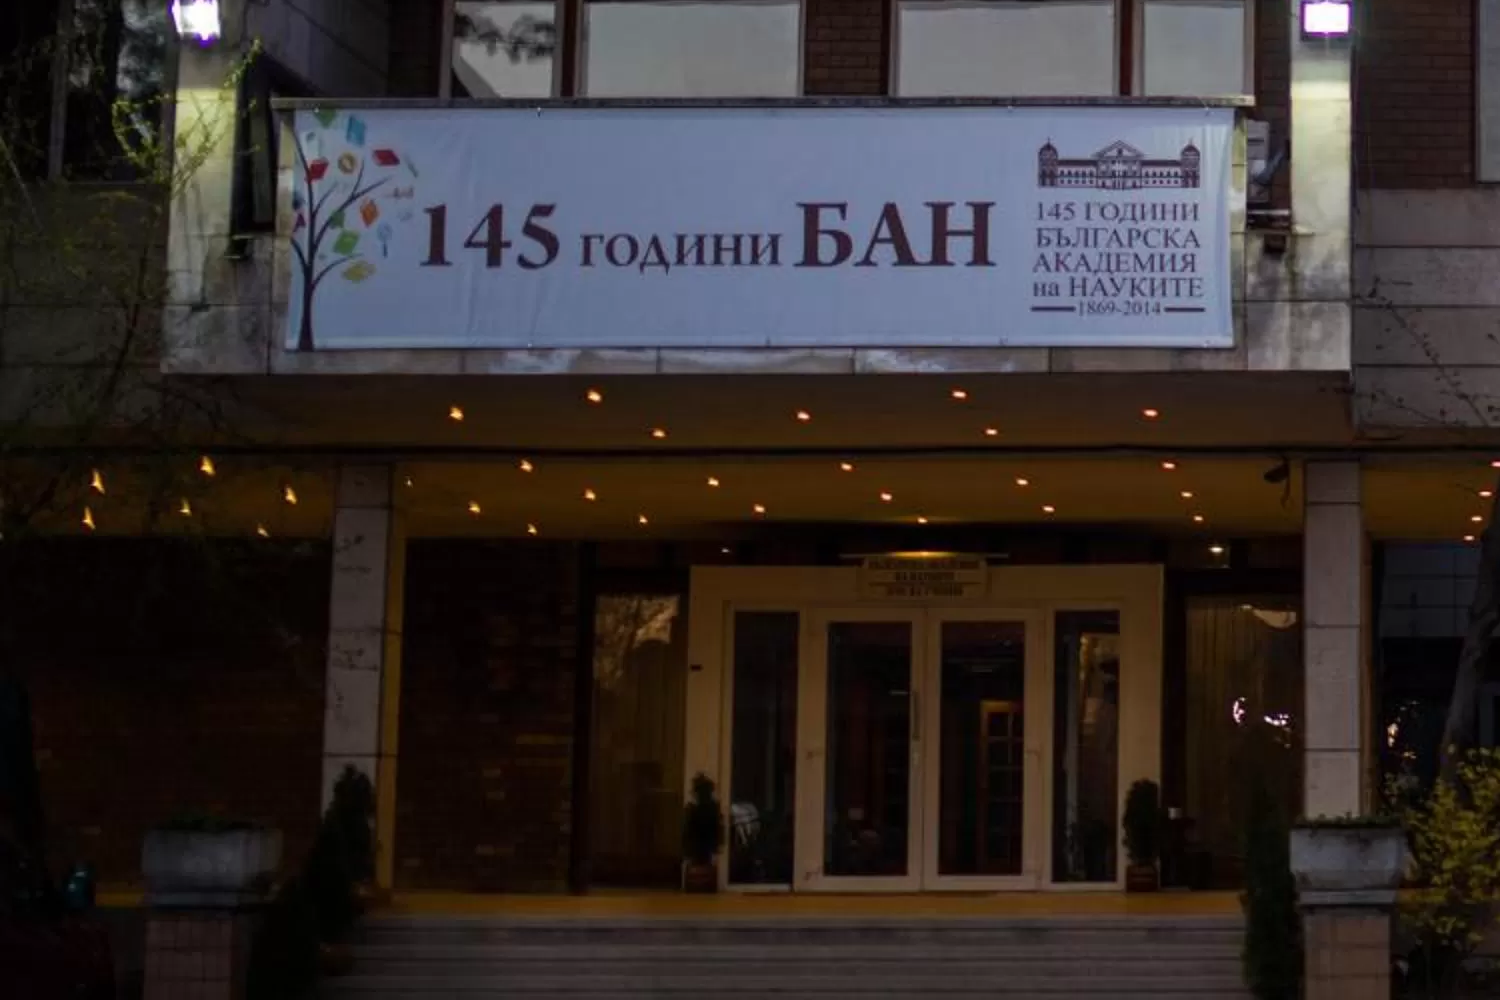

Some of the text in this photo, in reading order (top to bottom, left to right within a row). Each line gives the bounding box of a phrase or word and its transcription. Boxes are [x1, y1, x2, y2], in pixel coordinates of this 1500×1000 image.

[1037, 202, 1200, 224] 145 ГОДИНИ
[420, 201, 997, 275] 145 години БАН
[1036, 227, 1201, 249] БЪЛГАРСКА
[1032, 251, 1196, 275] АКАДЕМИЯ
[1032, 277, 1204, 298] на НАУКИТЕ
[1078, 301, 1161, 316] 1869-2014
